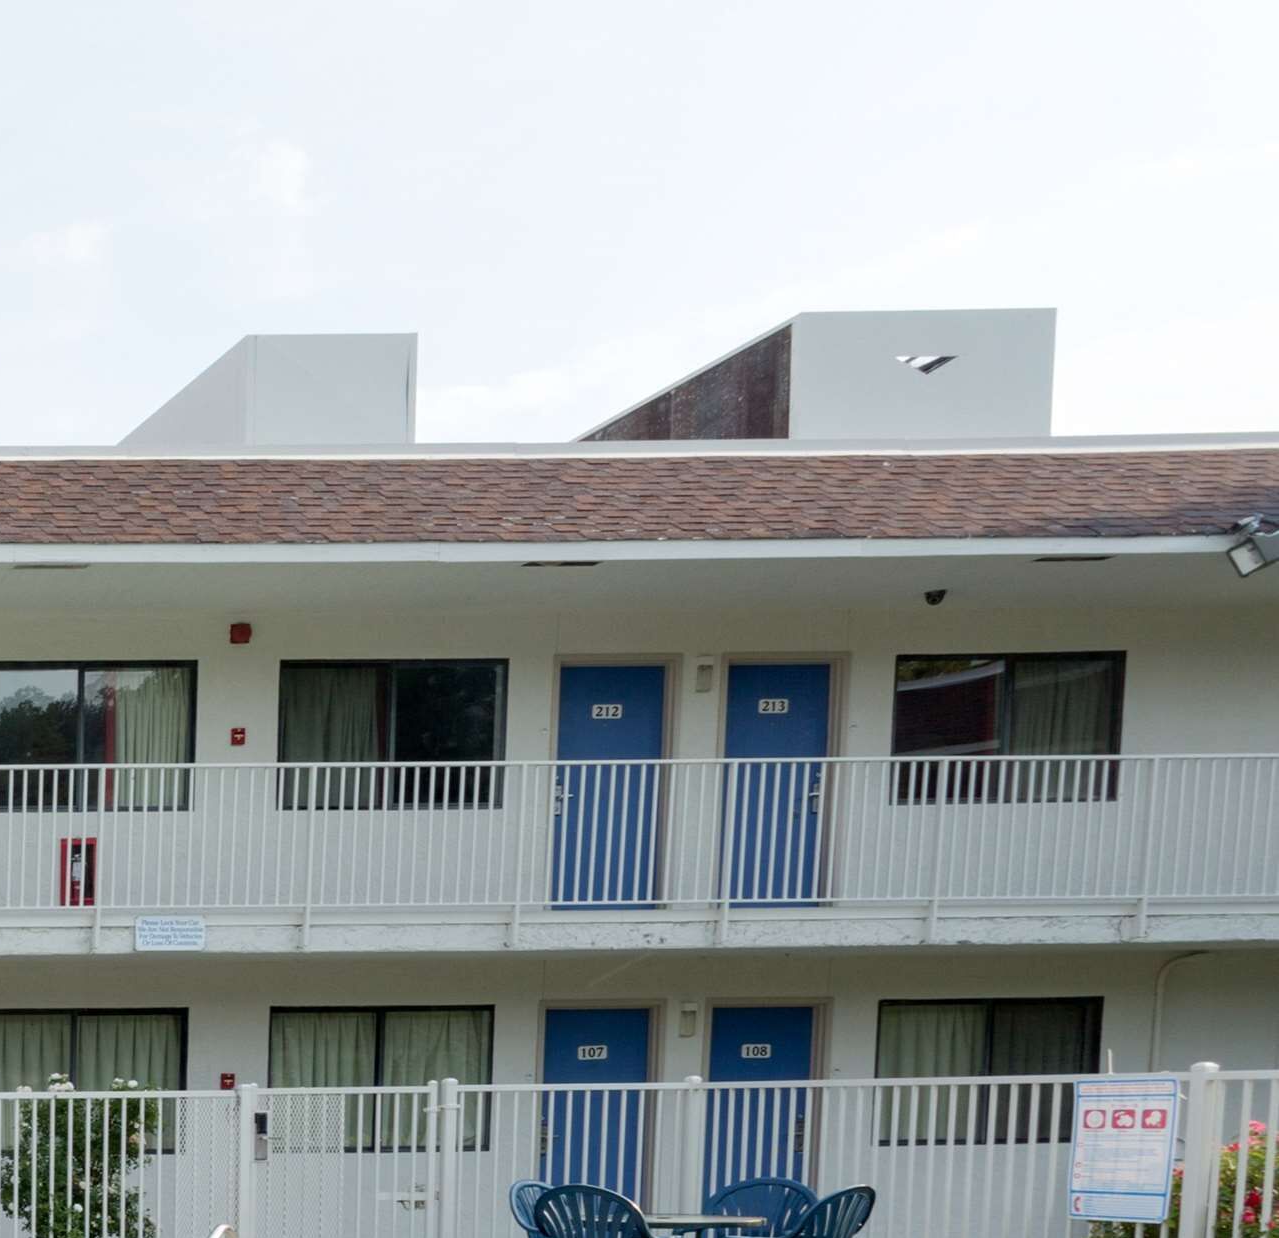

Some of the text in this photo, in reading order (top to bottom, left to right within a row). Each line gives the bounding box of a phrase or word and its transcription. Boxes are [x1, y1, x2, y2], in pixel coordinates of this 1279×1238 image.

[595, 706, 620, 717] 212
[761, 700, 786, 712] 213
[581, 1047, 604, 1059] 107
[744, 1046, 768, 1057] 108
